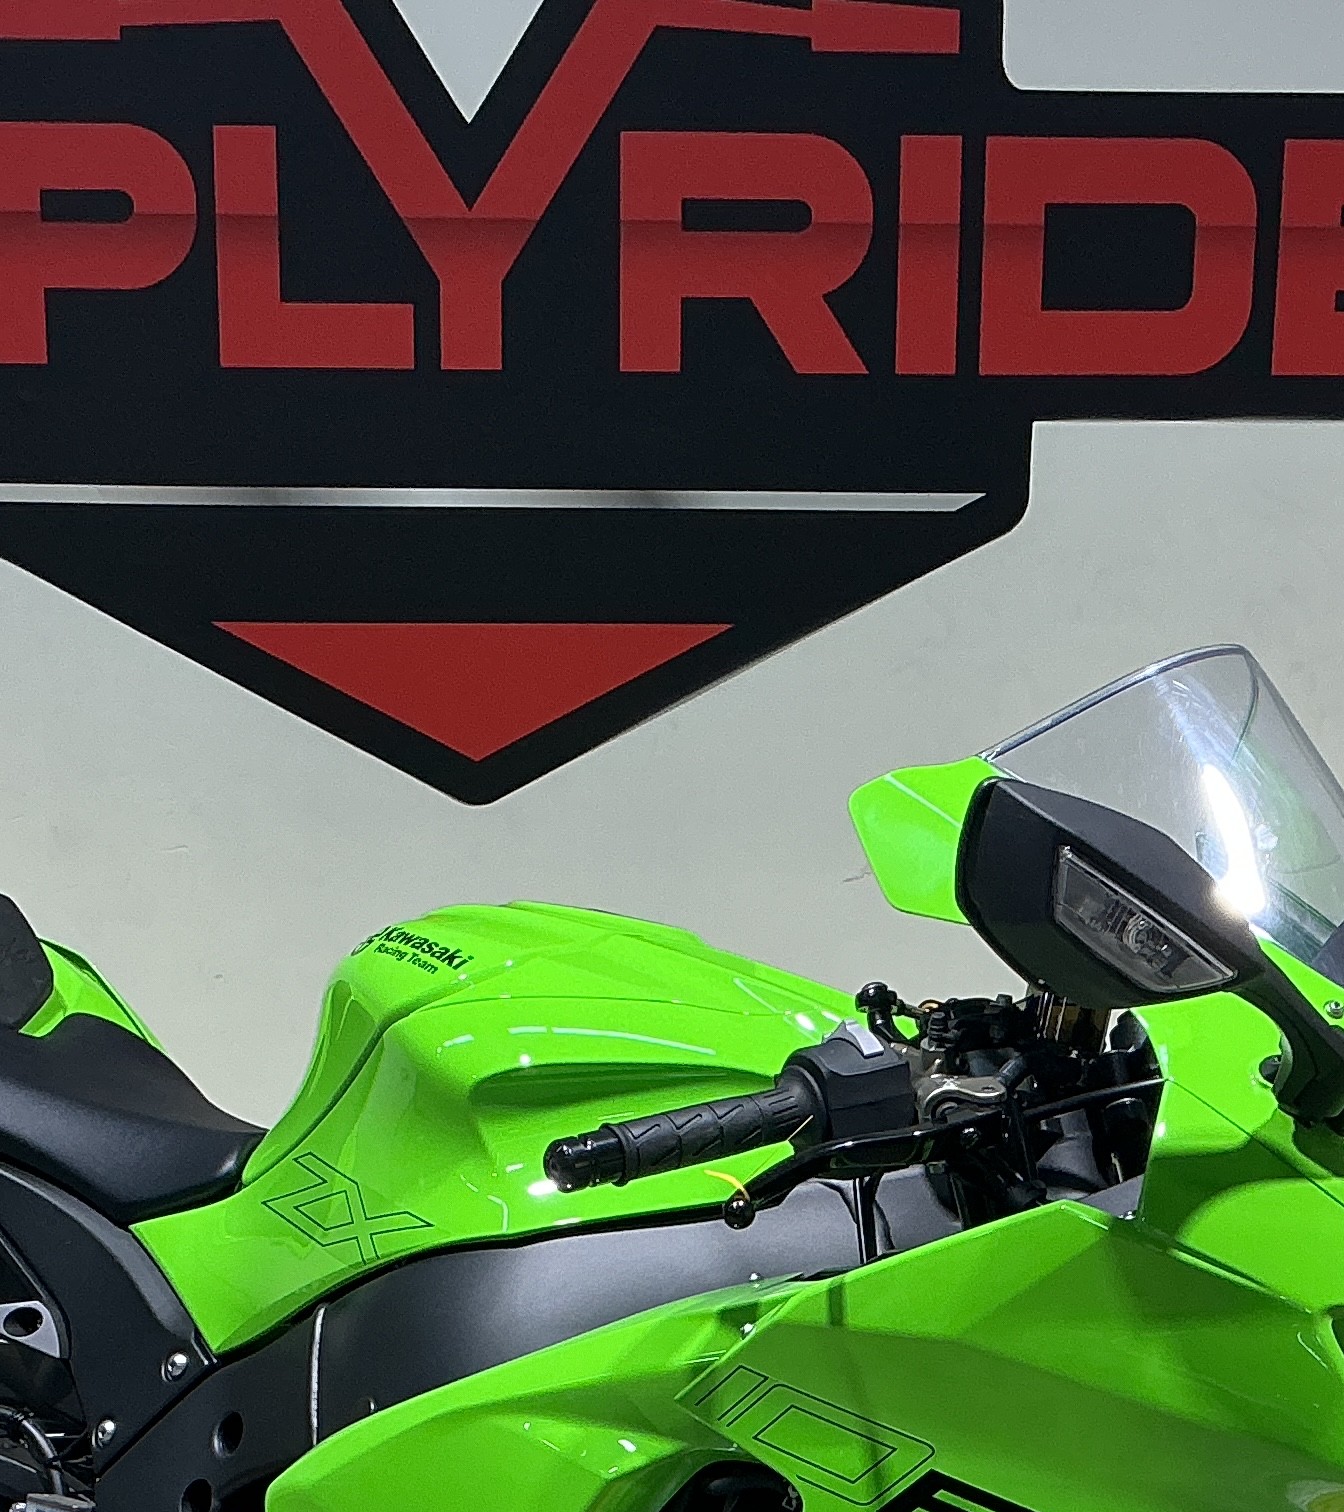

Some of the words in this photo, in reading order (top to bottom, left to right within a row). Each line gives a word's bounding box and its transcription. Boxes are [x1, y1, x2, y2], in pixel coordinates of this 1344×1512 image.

[373, 942, 409, 962] Racing
[406, 952, 439, 975] Team
[377, 926, 475, 971] Kawasaki
